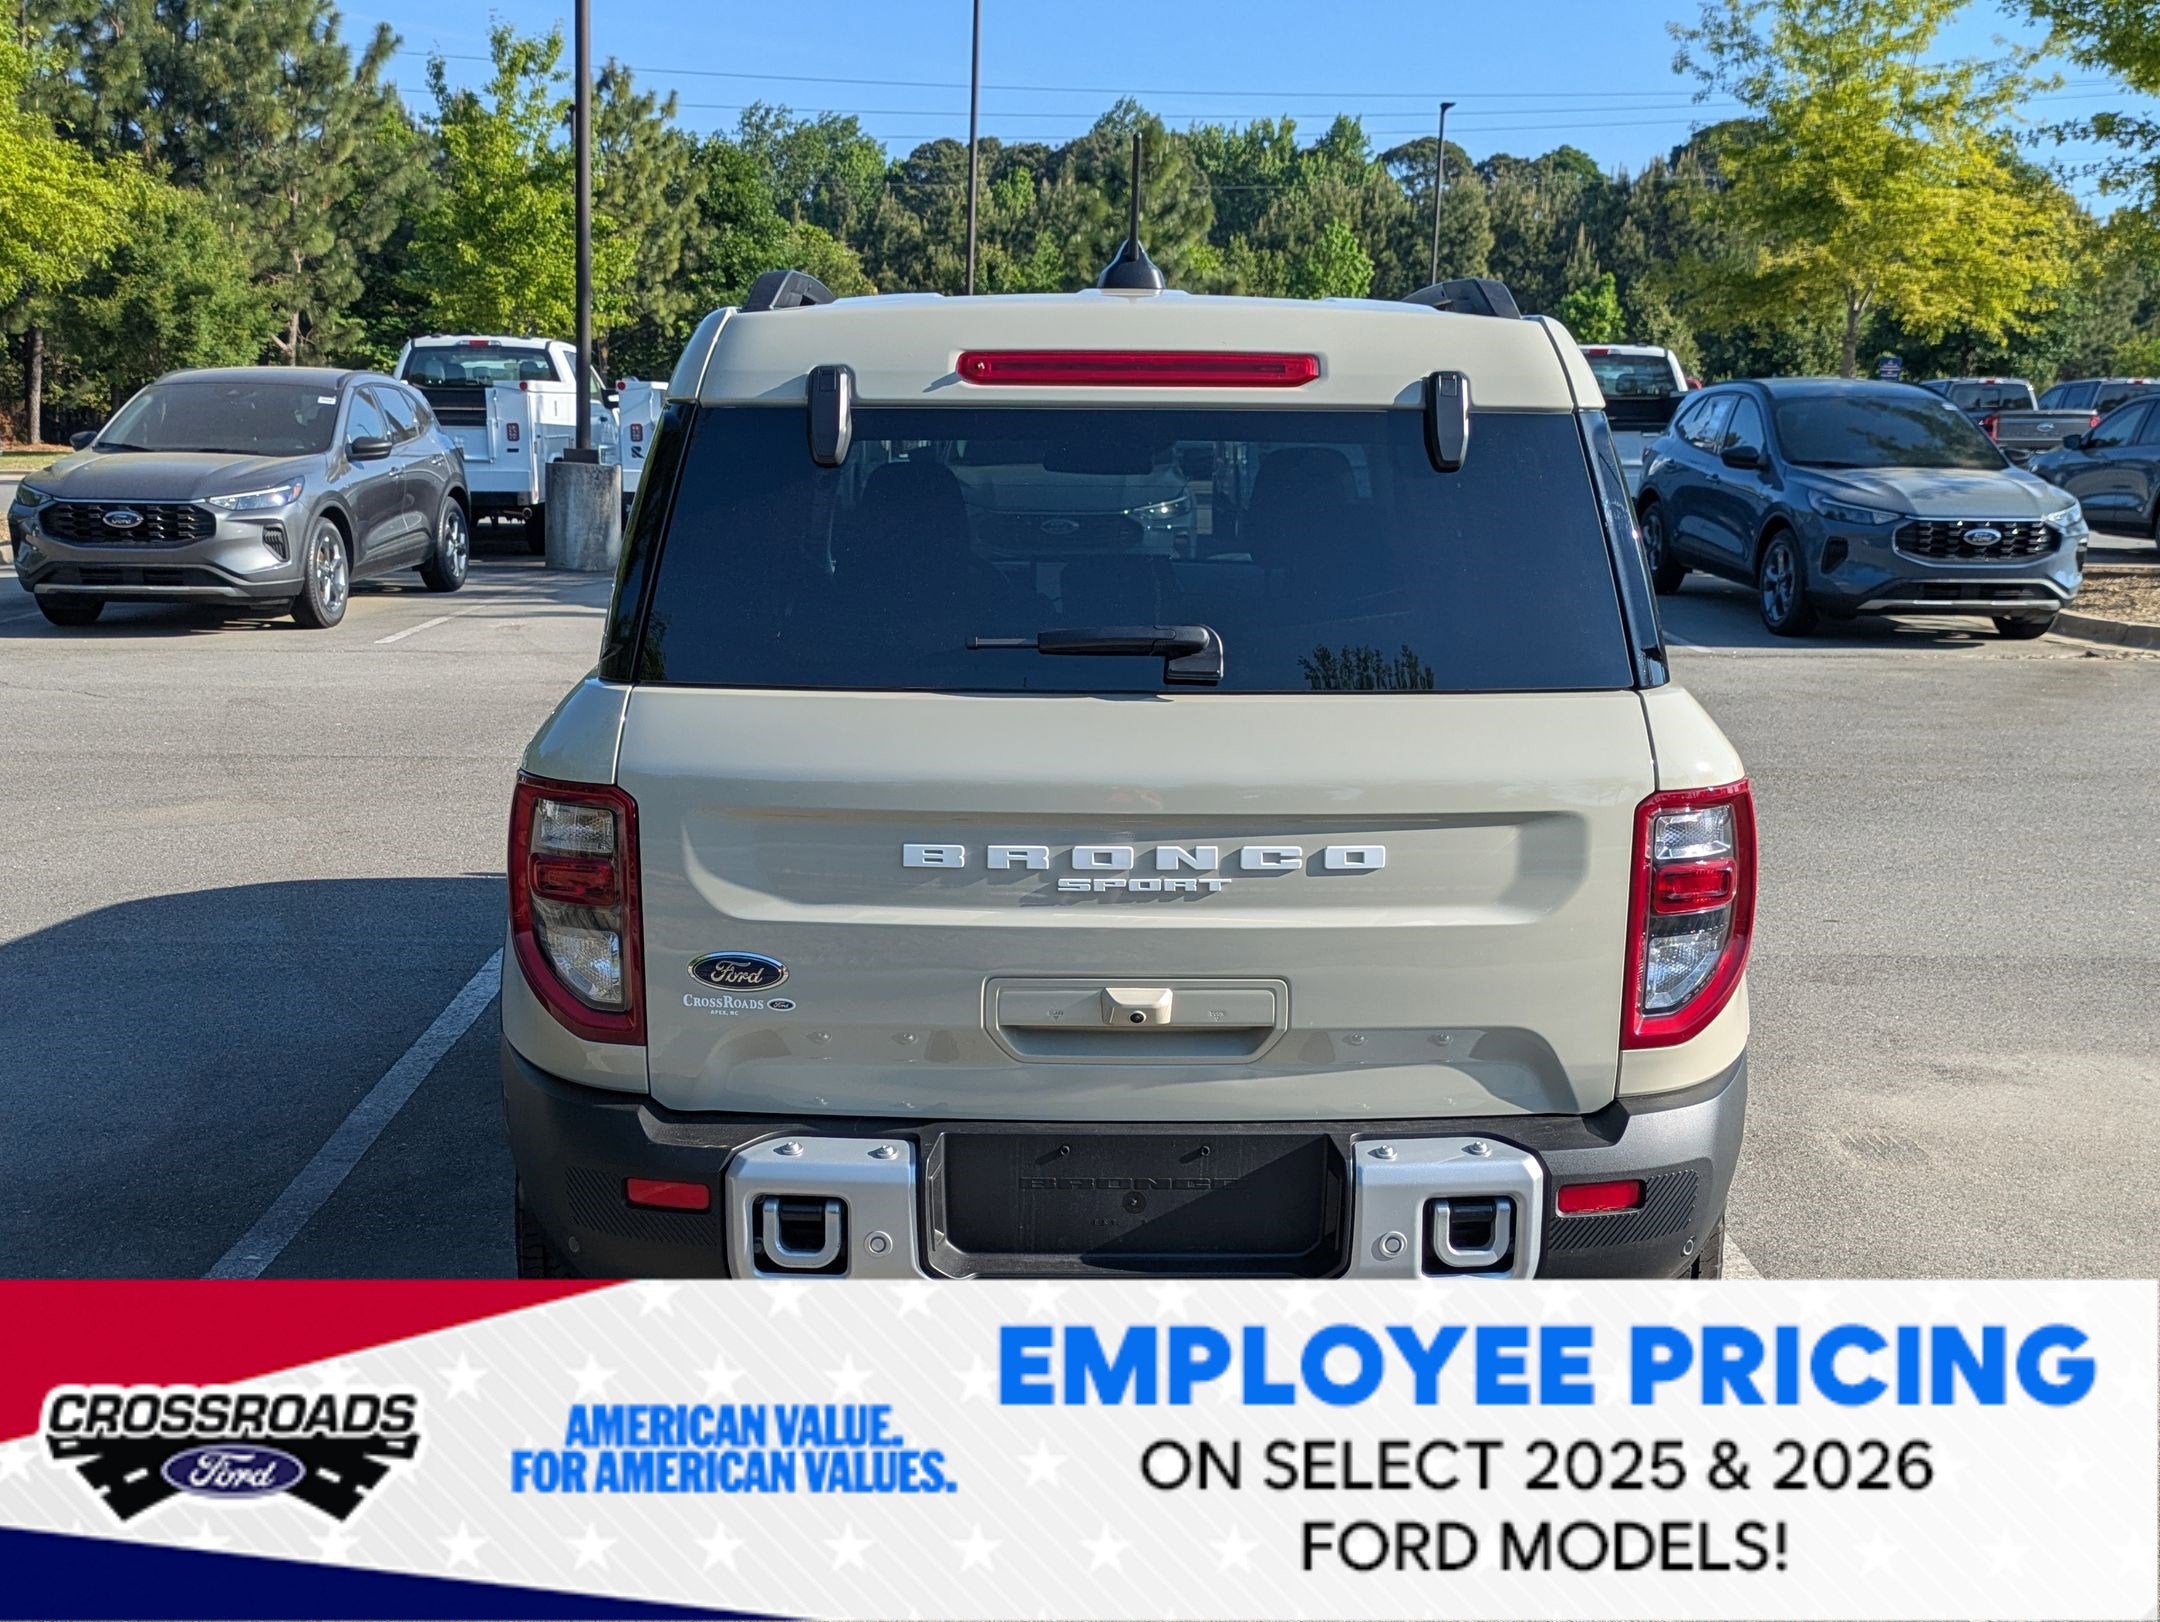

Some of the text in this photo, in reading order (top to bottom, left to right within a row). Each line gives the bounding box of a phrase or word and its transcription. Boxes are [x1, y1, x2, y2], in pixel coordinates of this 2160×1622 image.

[903, 844, 1386, 870] BRONCO
[1057, 878, 1232, 893] SPORT
[710, 960, 765, 984] Ford
